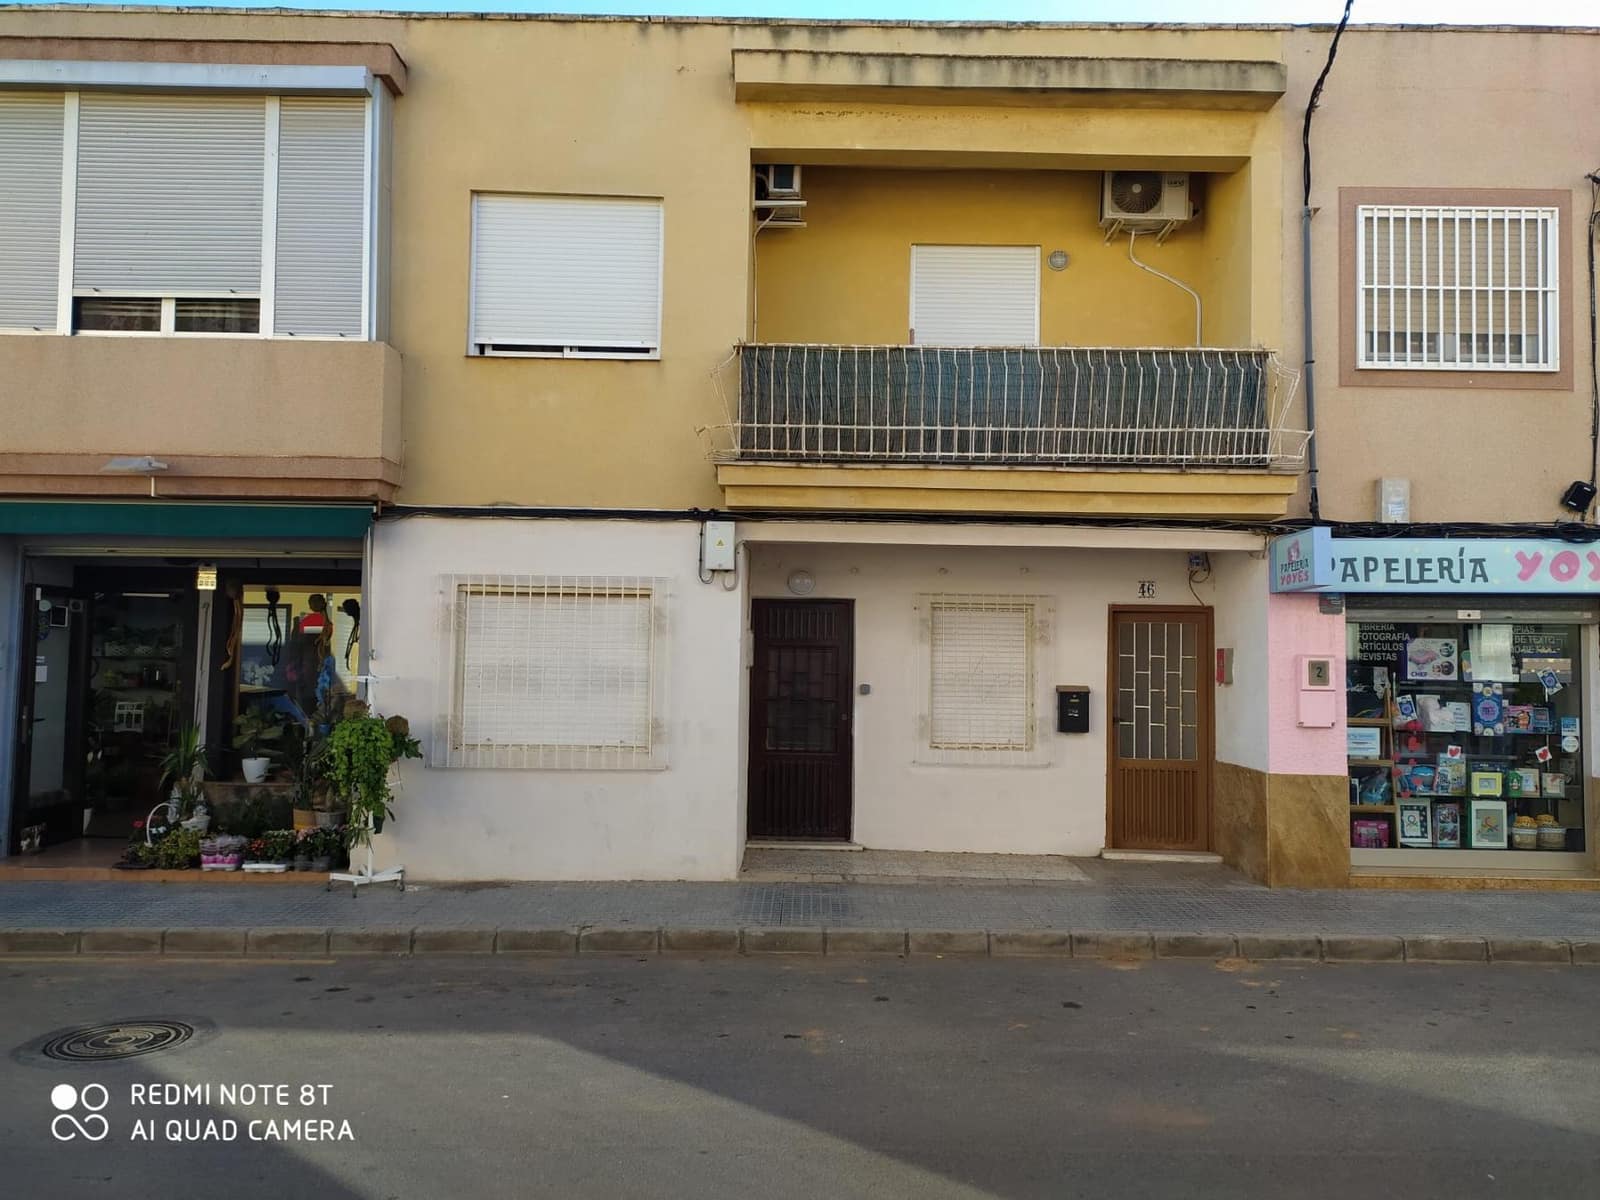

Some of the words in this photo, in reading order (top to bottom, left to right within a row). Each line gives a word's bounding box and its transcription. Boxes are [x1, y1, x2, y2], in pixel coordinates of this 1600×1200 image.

[1331, 547, 1489, 584] APELERÍA
[1280, 570, 1310, 585] YOYES
[1138, 582, 1155, 597] 46
[1357, 652, 1398, 661] REVISTAS
[1316, 666, 1323, 678] 2
